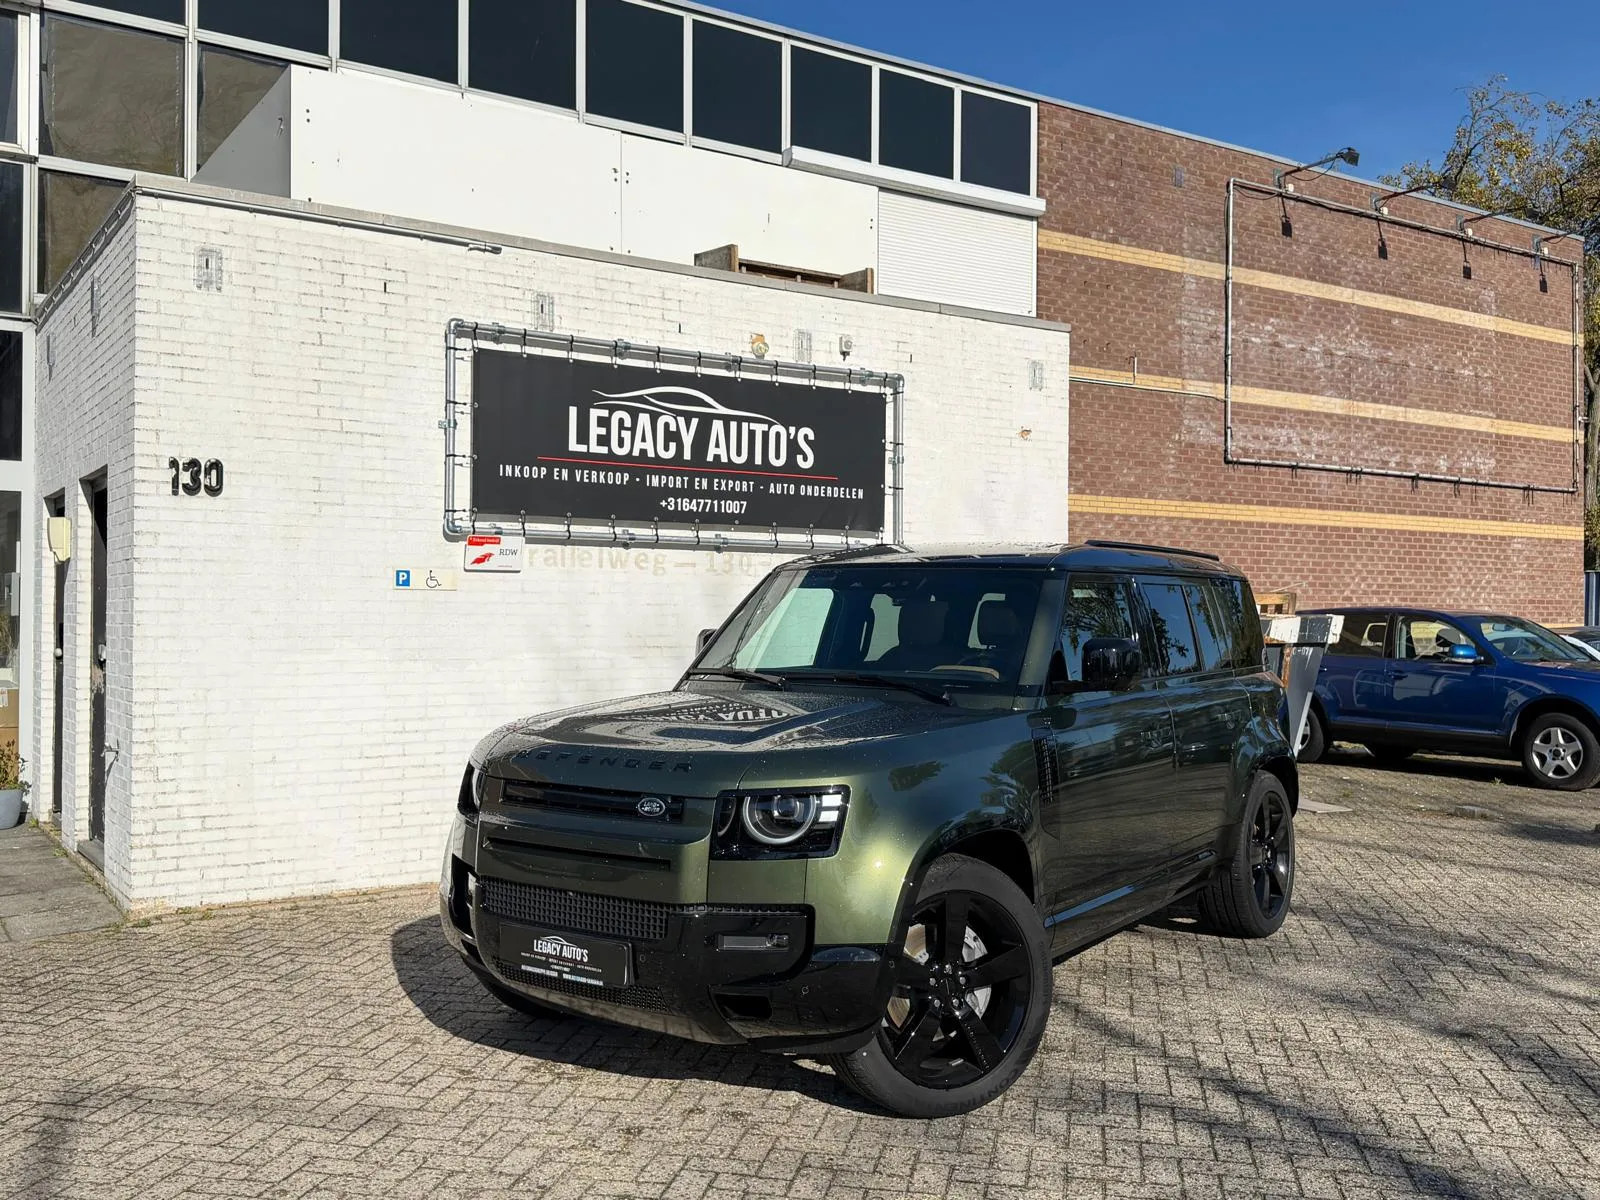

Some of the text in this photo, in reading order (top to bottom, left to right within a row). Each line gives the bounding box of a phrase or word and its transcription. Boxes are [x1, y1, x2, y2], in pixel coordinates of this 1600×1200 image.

[568, 405, 815, 469] LEGACY AUTO'S
[168, 456, 224, 497] 130
[499, 464, 547, 479] INKOOP
[553, 468, 569, 481] EN
[575, 469, 630, 485] VERKOOP
[646, 474, 689, 489] IMPORT
[694, 477, 708, 490] EN
[713, 478, 755, 493] EXPORT
[769, 483, 795, 495] AUTO
[800, 484, 864, 500] ONDERDELEN
[659, 497, 747, 514] +31647711007
[499, 548, 519, 556] RDW
[398, 571, 408, 585] P
[533, 939, 561, 956] LEGACY
[561, 945, 589, 963] AUTO'S
